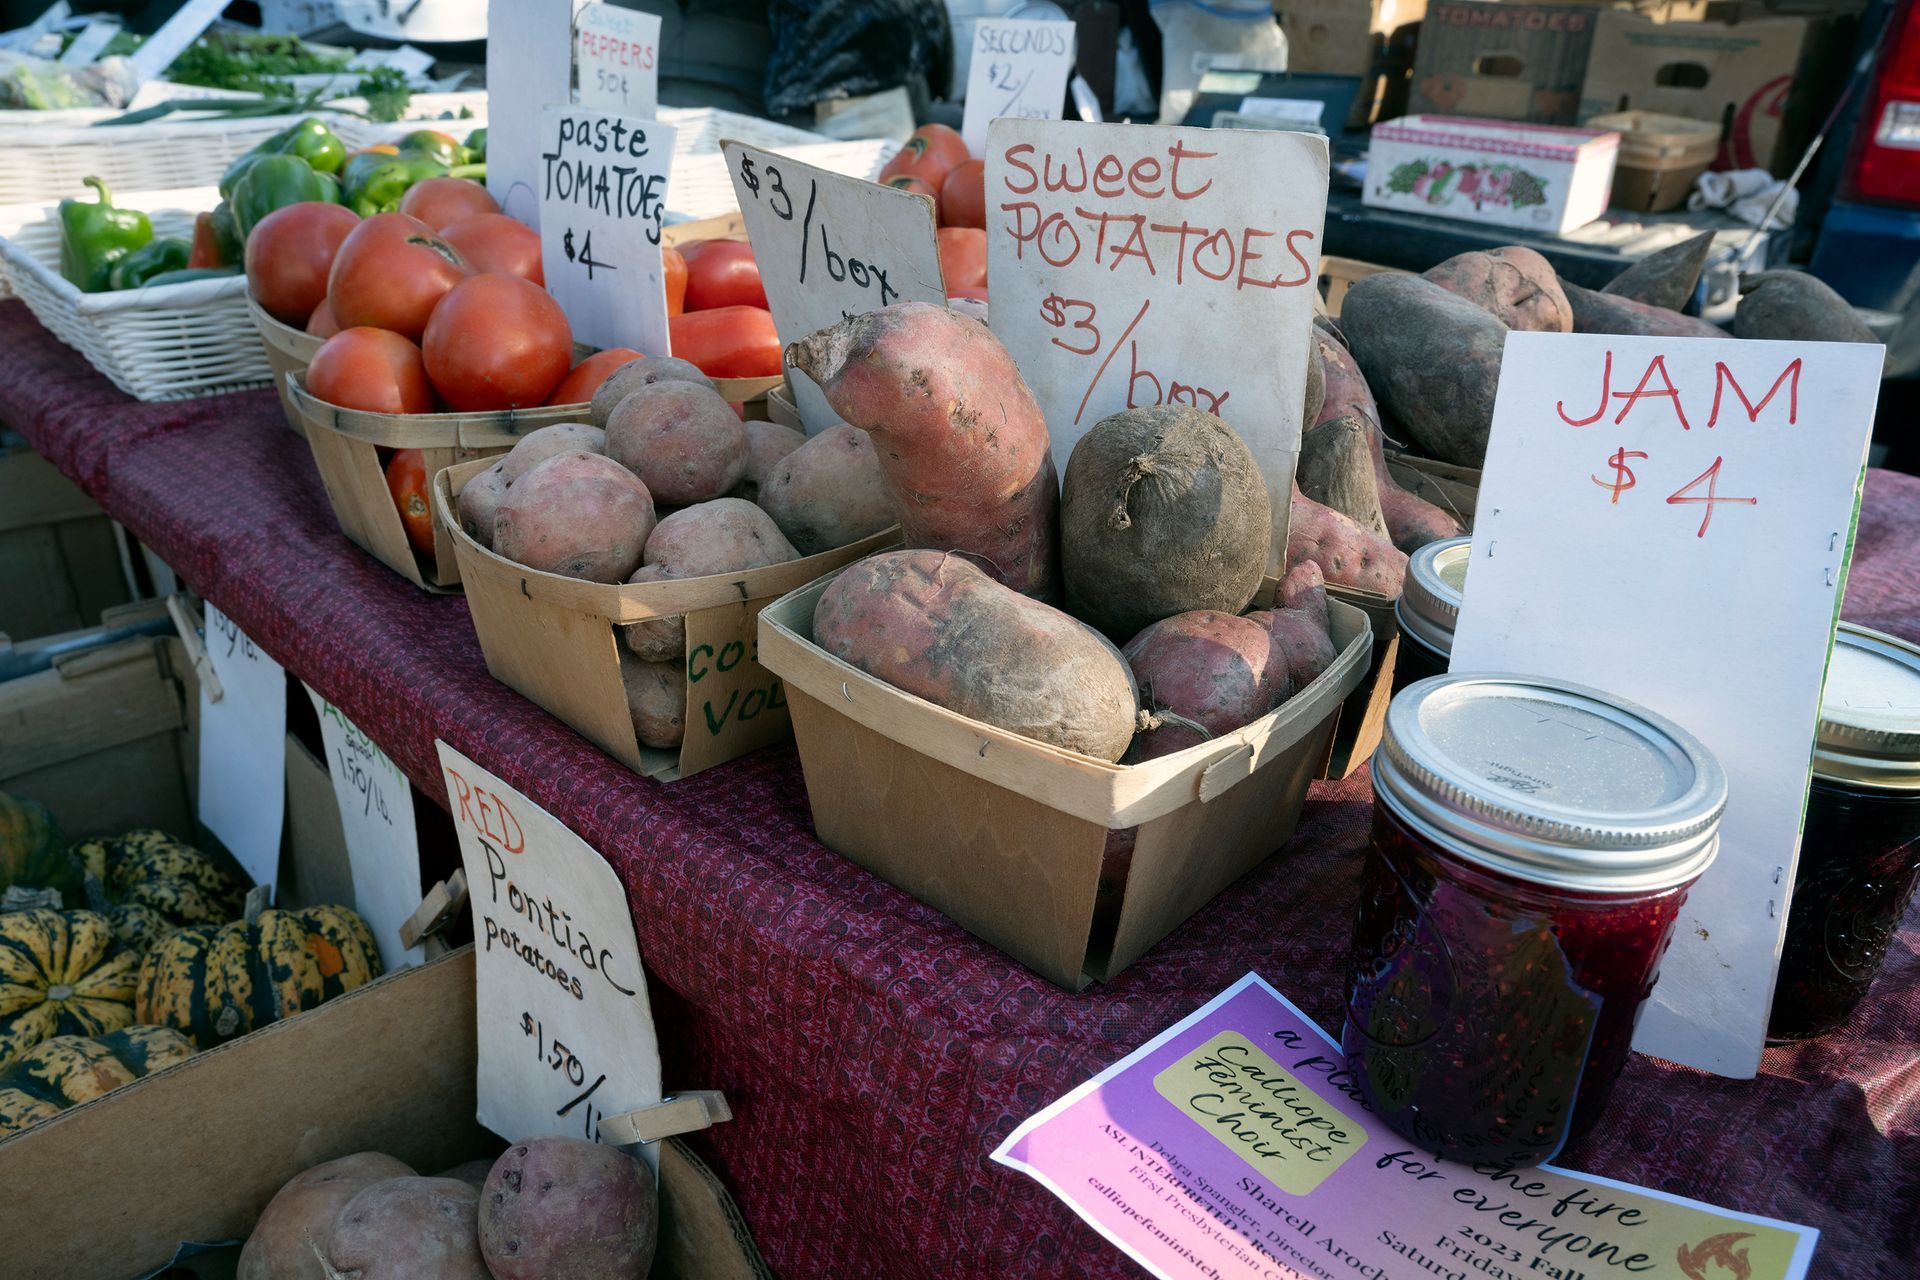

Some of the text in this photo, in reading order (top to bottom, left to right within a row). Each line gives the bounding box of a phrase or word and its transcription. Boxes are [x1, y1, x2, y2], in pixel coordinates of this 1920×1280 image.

[583, 31, 654, 70] PEPPERS
[979, 25, 1066, 56] SECONDS
[558, 117, 649, 159] paste
[542, 153, 667, 245] TOMATOES
[564, 228, 617, 280] $4
[1001, 202, 1314, 291] POTATOES
[1556, 350, 1801, 431] JAM
[688, 640, 758, 683] CO
[446, 767, 525, 854] RED
[477, 836, 636, 996] Pontiac
[484, 915, 584, 1001] potatoes
[1274, 1030, 1305, 1050] a
[1189, 1093, 1287, 1161] Choir
[1194, 1056, 1332, 1162] Feminist
[1217, 1045, 1350, 1145] Calliope
[1099, 1122, 1127, 1148] ASL
[1129, 1145, 1238, 1232] INTERPRETED
[1129, 1165, 1165, 1196] First
[1165, 1192, 1261, 1271] Presbyterian
[1150, 1140, 1193, 1179] Debra
[1265, 1230, 1335, 1280] Director
[1236, 1176, 1317, 1237] Sharell
[1376, 1151, 1657, 1273] for everyone
[1551, 1188, 1648, 1227] fire
[1457, 1225, 1522, 1263] 2023
